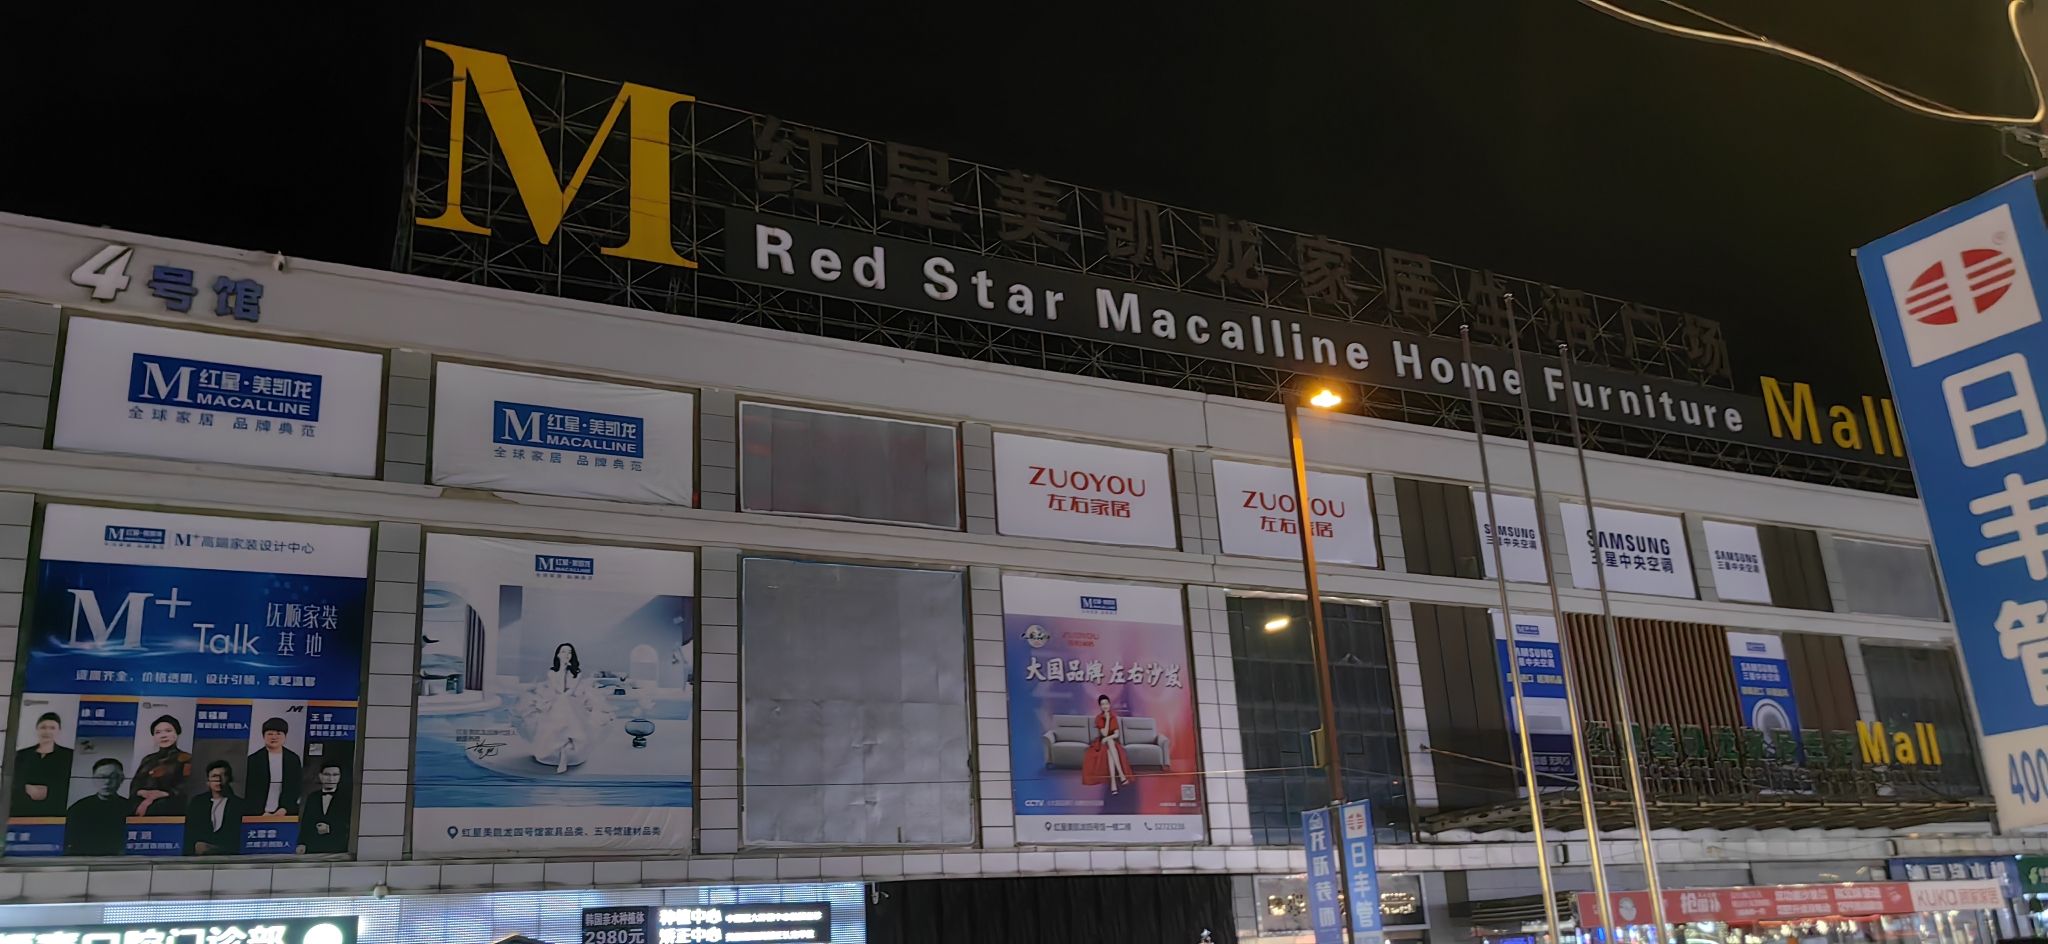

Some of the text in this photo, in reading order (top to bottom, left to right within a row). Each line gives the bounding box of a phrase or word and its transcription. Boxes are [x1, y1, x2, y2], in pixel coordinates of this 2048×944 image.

[415, 39, 698, 268] M
[70, 244, 265, 323] 4号馆
[755, 223, 1904, 457] Red Star Macalline Home Furniture Mall
[139, 361, 197, 403] M
[198, 368, 312, 400] 红星·美凯龙
[196, 393, 311, 417] MACALLINE
[128, 405, 316, 438] 全球家居 品牌典范
[502, 408, 544, 444] M
[546, 413, 637, 440] 红星·美凯龙
[493, 446, 643, 472] 全球家居 品牌典范
[546, 434, 637, 454] MACALLINE
[1028, 465, 1147, 498] ZUOYOU
[1048, 493, 1131, 518] 左右家居
[1241, 490, 1345, 518] ZUOOU
[1483, 523, 1536, 540] SMSUNG
[1941, 352, 2048, 707] 日丰管
[1714, 550, 1759, 564] SAMSUNG
[1717, 561, 1760, 574] 三星中央空调
[266, 601, 339, 631] 抚顺家装
[193, 622, 261, 657] Talk
[277, 630, 322, 658] 基地
[1025, 656, 1183, 689] 大国品牌 左右沙发
[1856, 720, 1942, 765] Mall
[1350, 842, 1374, 927] 日丰管
[585, 928, 645, 944] 2980元
